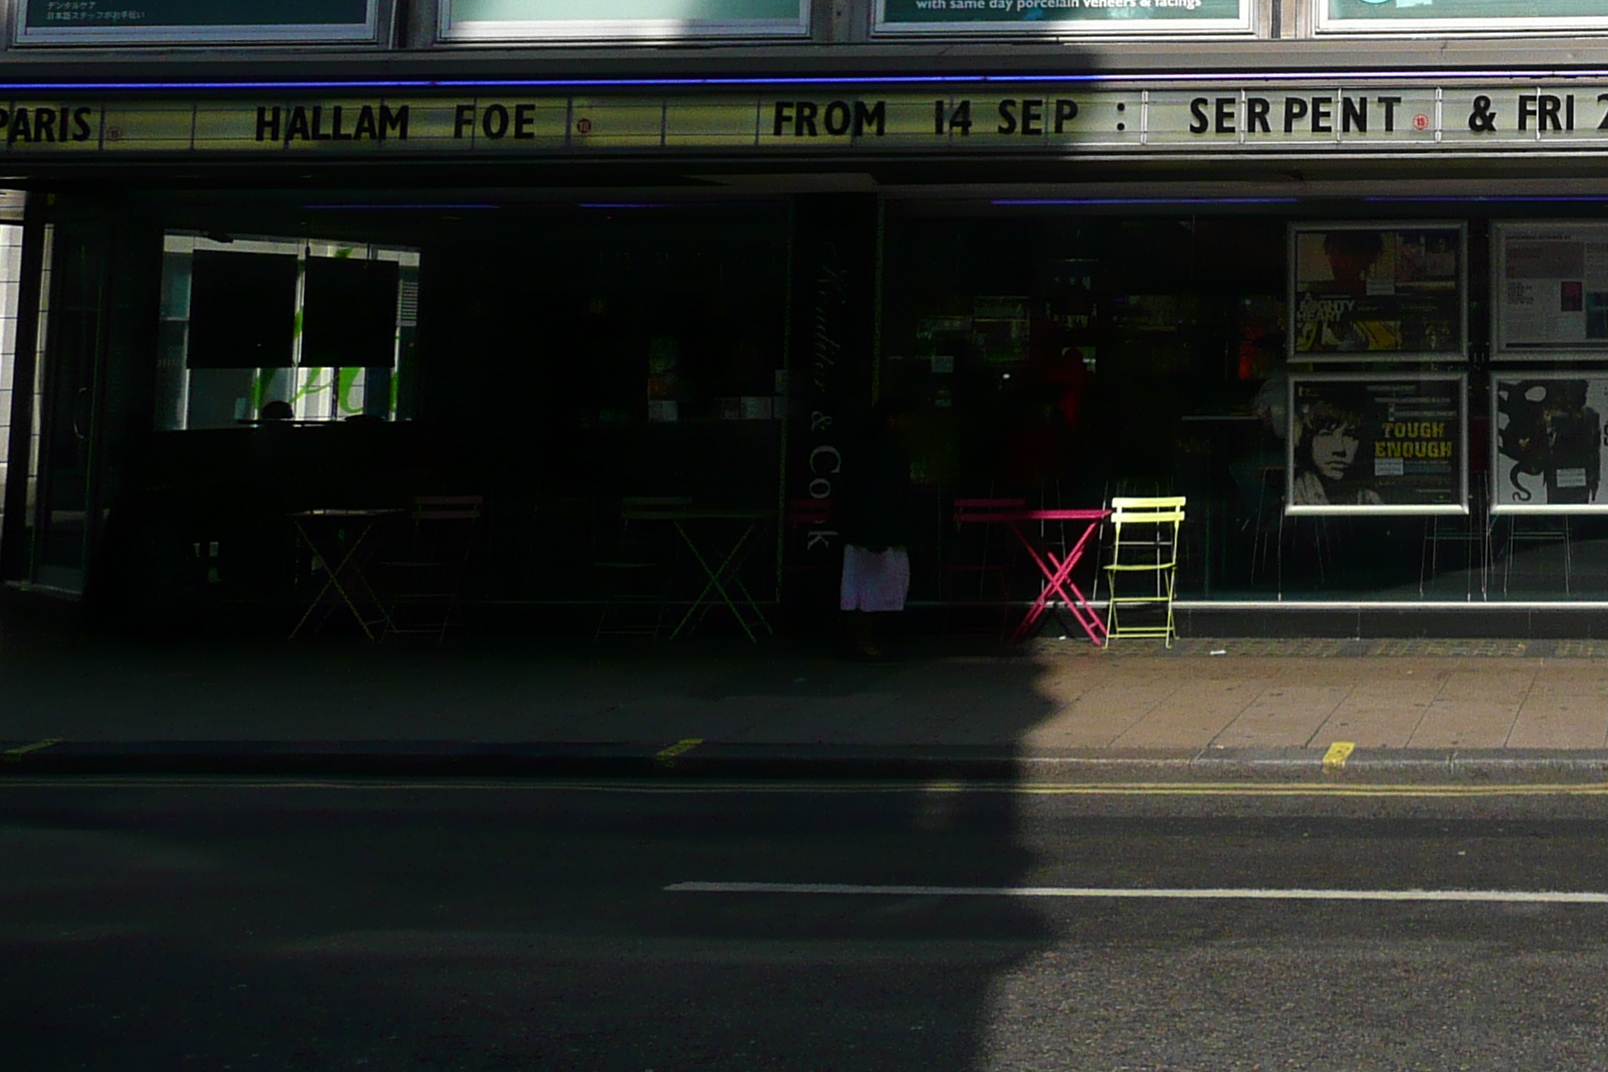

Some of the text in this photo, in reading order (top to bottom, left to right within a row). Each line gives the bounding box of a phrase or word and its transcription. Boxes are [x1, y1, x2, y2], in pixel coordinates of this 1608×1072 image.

[255, 103, 409, 142] HALLAM
[453, 102, 537, 140] FOE
[773, 99, 886, 137] FROM
[934, 98, 973, 137] 14
[997, 98, 1079, 136] SEP
[1189, 96, 1402, 134] SERPENT
[1468, 95, 1497, 132] &
[1518, 94, 1574, 131] FRI
[811, 410, 833, 431] &
[1382, 421, 1446, 439] TOUGH
[1374, 441, 1453, 459] ENOUGH
[808, 445, 842, 550] Cok
